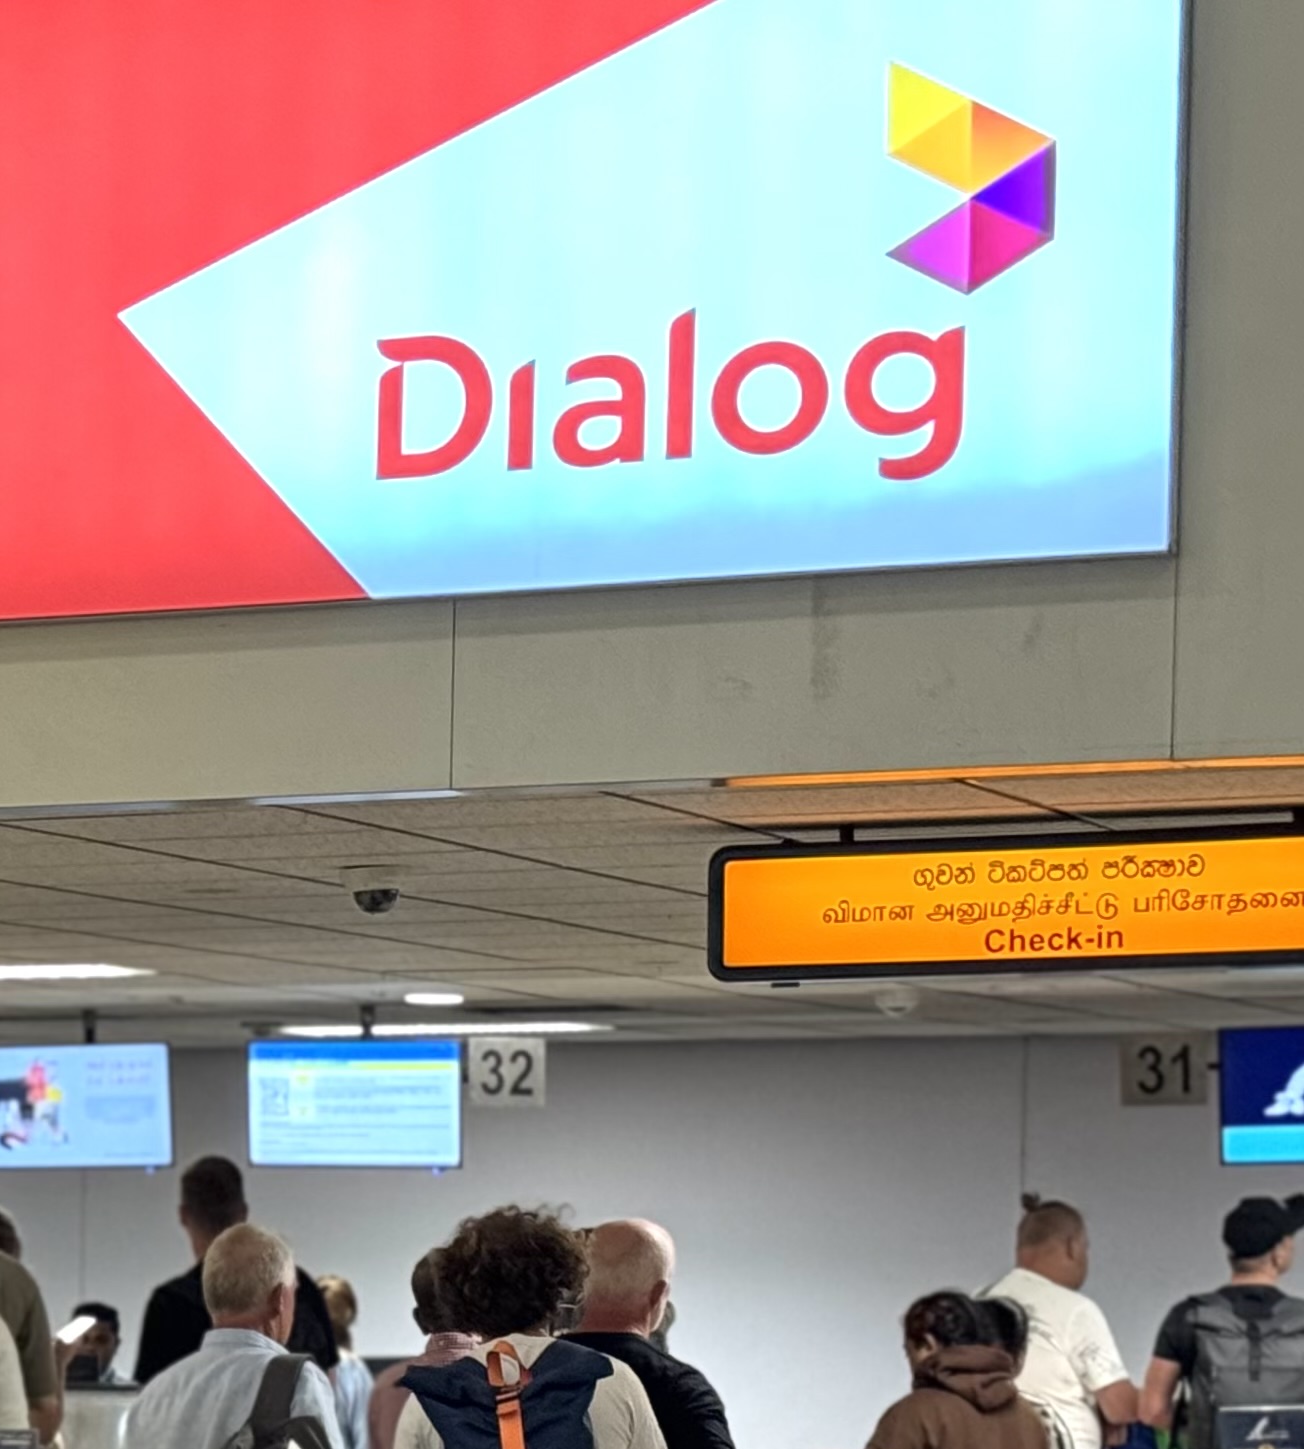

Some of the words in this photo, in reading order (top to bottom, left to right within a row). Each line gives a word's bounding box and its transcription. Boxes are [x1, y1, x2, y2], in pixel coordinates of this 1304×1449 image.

[376, 308, 965, 481] Dialog
[913, 862, 976, 891] ගුවන්
[822, 899, 915, 924] விமான
[925, 891, 1120, 925] அனுமதிச்சீட்டு
[984, 925, 1124, 954] Check-in
[480, 1048, 534, 1097] 32
[1136, 1043, 1191, 1095] 31
